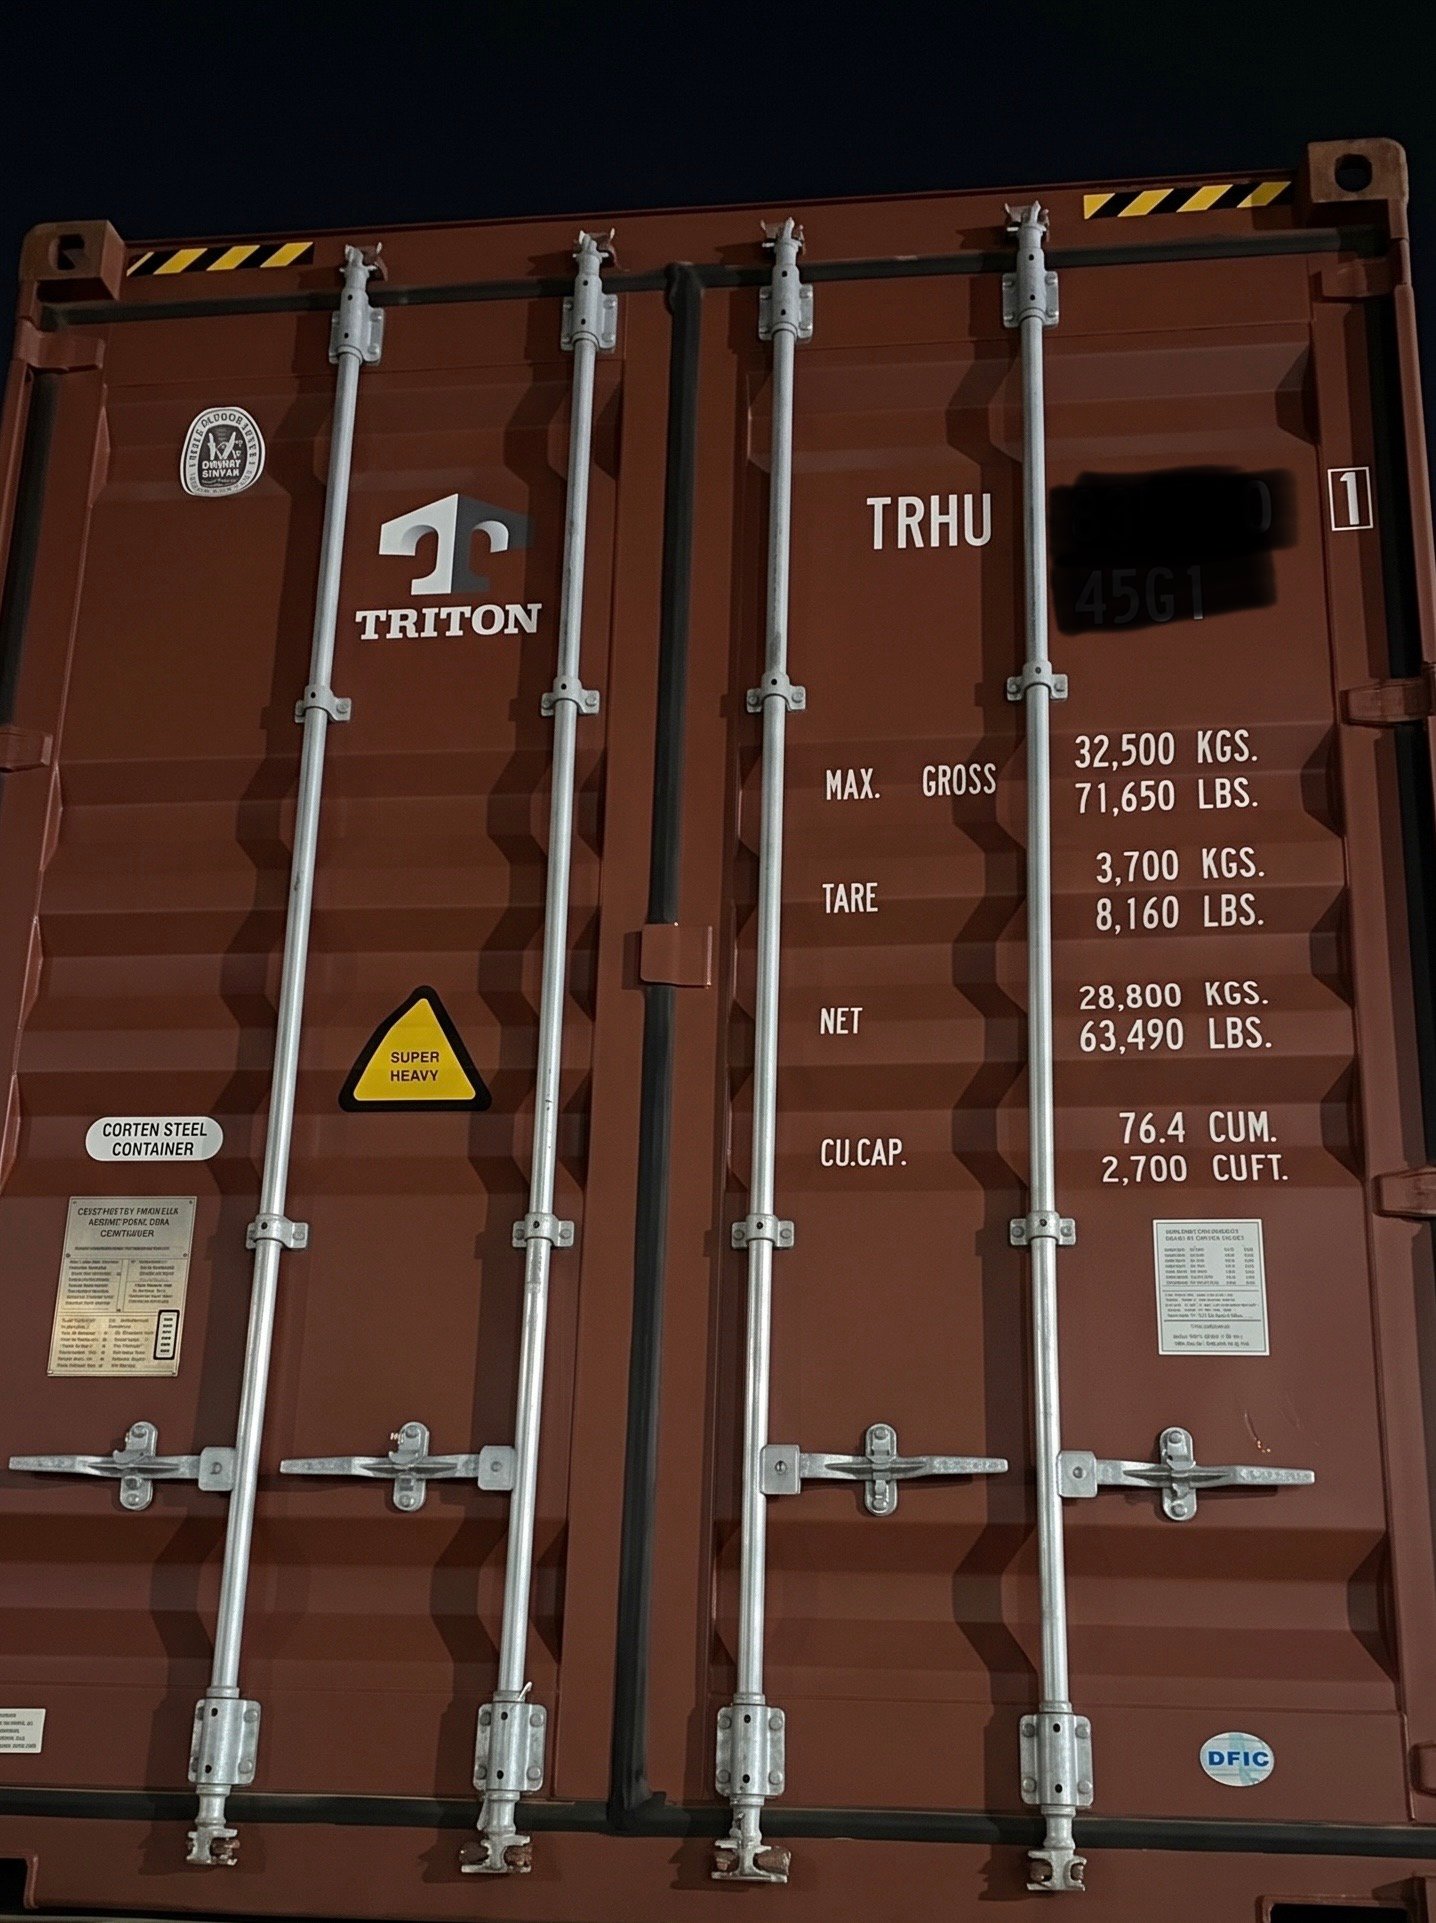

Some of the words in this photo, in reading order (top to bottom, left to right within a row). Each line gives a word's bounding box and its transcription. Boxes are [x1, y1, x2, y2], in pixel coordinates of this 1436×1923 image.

[1339, 471, 1361, 526] 1
[867, 494, 990, 549] TRHU
[356, 604, 541, 639] TRITON
[1075, 732, 1174, 770] 32,500
[1198, 730, 1257, 763] KGS.
[827, 769, 880, 800] MAX.
[923, 764, 995, 796] GROSS
[1076, 780, 1174, 816] 71,650
[1199, 778, 1257, 808] LBS.
[1097, 850, 1178, 886] 3,700
[1203, 847, 1264, 878] KGS.
[823, 883, 878, 913] TARE
[1097, 896, 1178, 934] 8,160
[1204, 894, 1263, 927] LBS.
[1080, 983, 1181, 1011] 28,800
[1205, 981, 1268, 1005] KGS.
[821, 1008, 862, 1034] NET
[1081, 1019, 1183, 1054] 63,490
[1209, 1017, 1271, 1048] LBS.
[391, 1052, 439, 1063] SUPER
[391, 1070, 438, 1081] HEAVY
[103, 1123, 159, 1137] CORTEN
[164, 1123, 207, 1136] STEEL
[1120, 1112, 1185, 1143] 76.4
[1210, 1111, 1276, 1142] CUM.
[113, 1142, 193, 1156] CONTAINER
[822, 1139, 906, 1166] CU.CAP.
[1103, 1156, 1186, 1185] 2,700
[1213, 1155, 1287, 1180] CUFT.
[1209, 1752, 1268, 1766] DFIC
